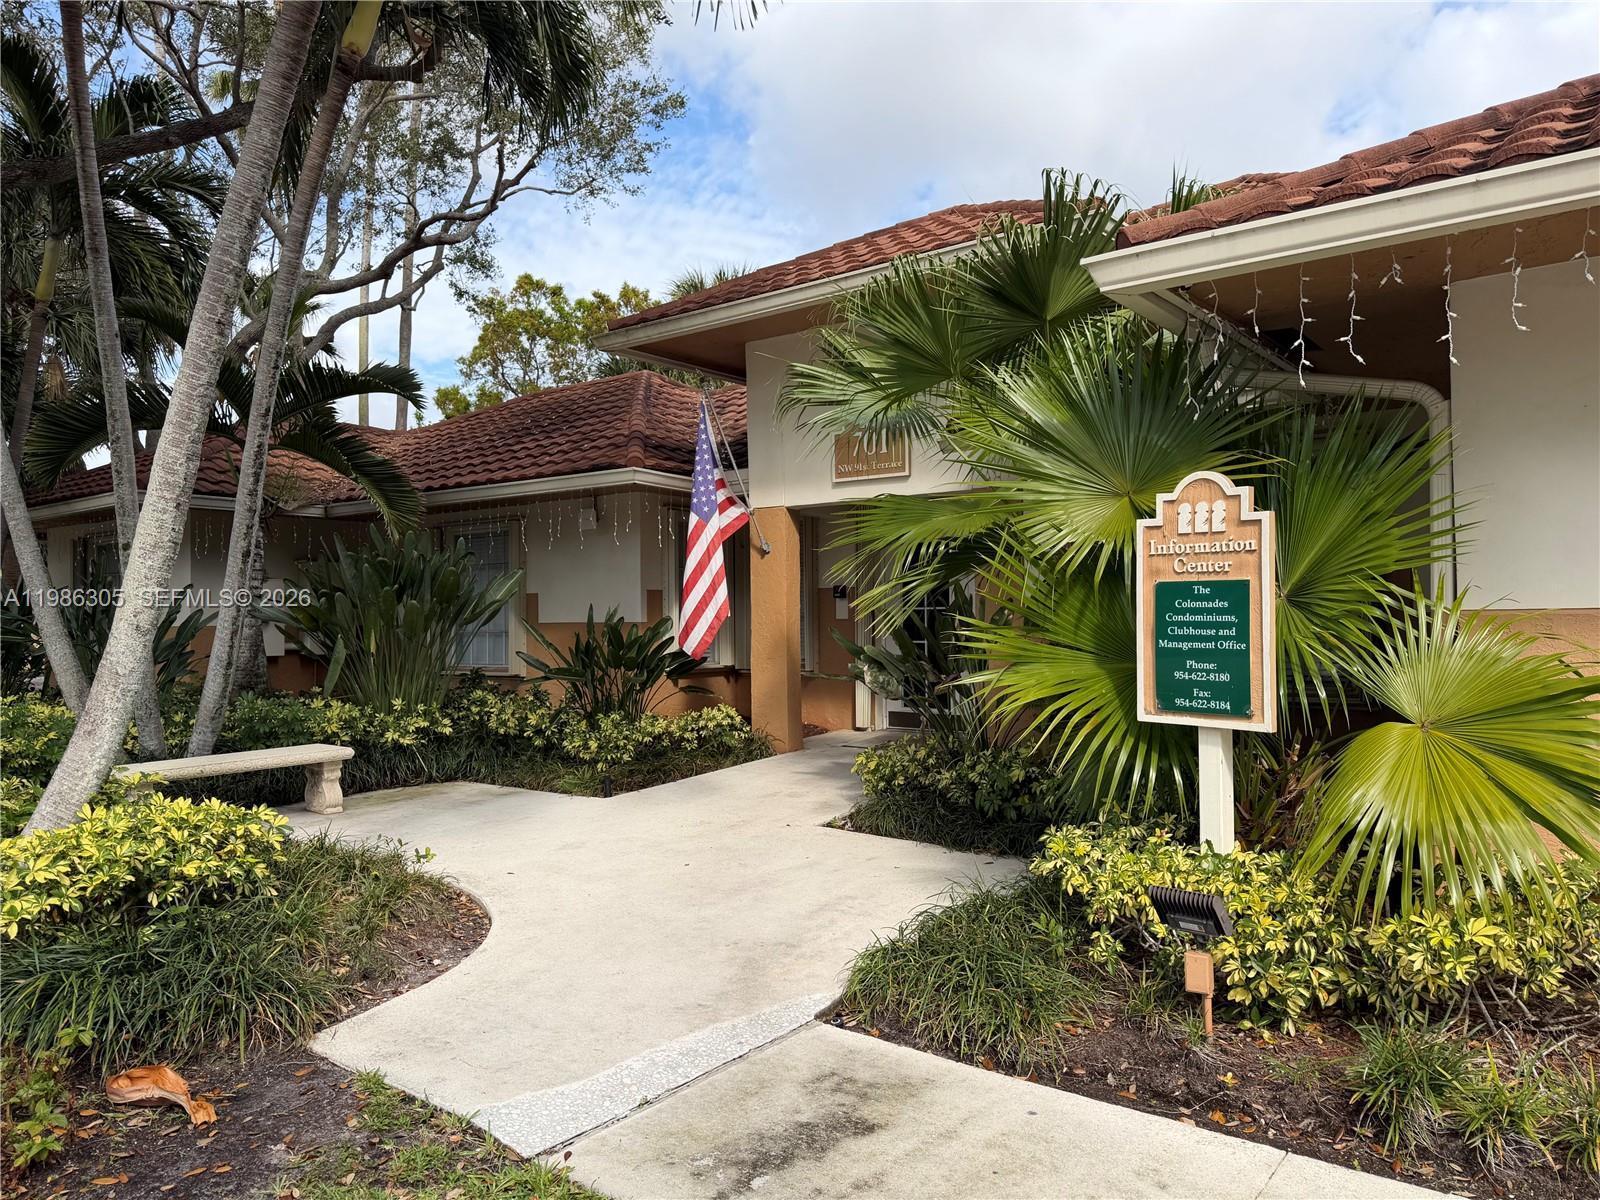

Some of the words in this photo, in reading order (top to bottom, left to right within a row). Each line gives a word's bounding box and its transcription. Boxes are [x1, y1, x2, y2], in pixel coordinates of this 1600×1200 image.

[1148, 537, 1257, 556] Information
[1173, 557, 1233, 574] Center
[1192, 585, 1211, 595] The
[1174, 599, 1229, 608] Colonnades
[1165, 612, 1239, 623] Condominiums,
[1167, 626, 1216, 636] Clubhouse
[1218, 626, 1236, 636] and
[1158, 639, 1216, 651] Management
[1217, 640, 1247, 650] Office
[1186, 660, 1217, 670] Phone:
[1174, 671, 1230, 682] 954-622-8180
[1193, 688, 1211, 698] Fax:
[1175, 698, 1231, 710] 954-622-8184
